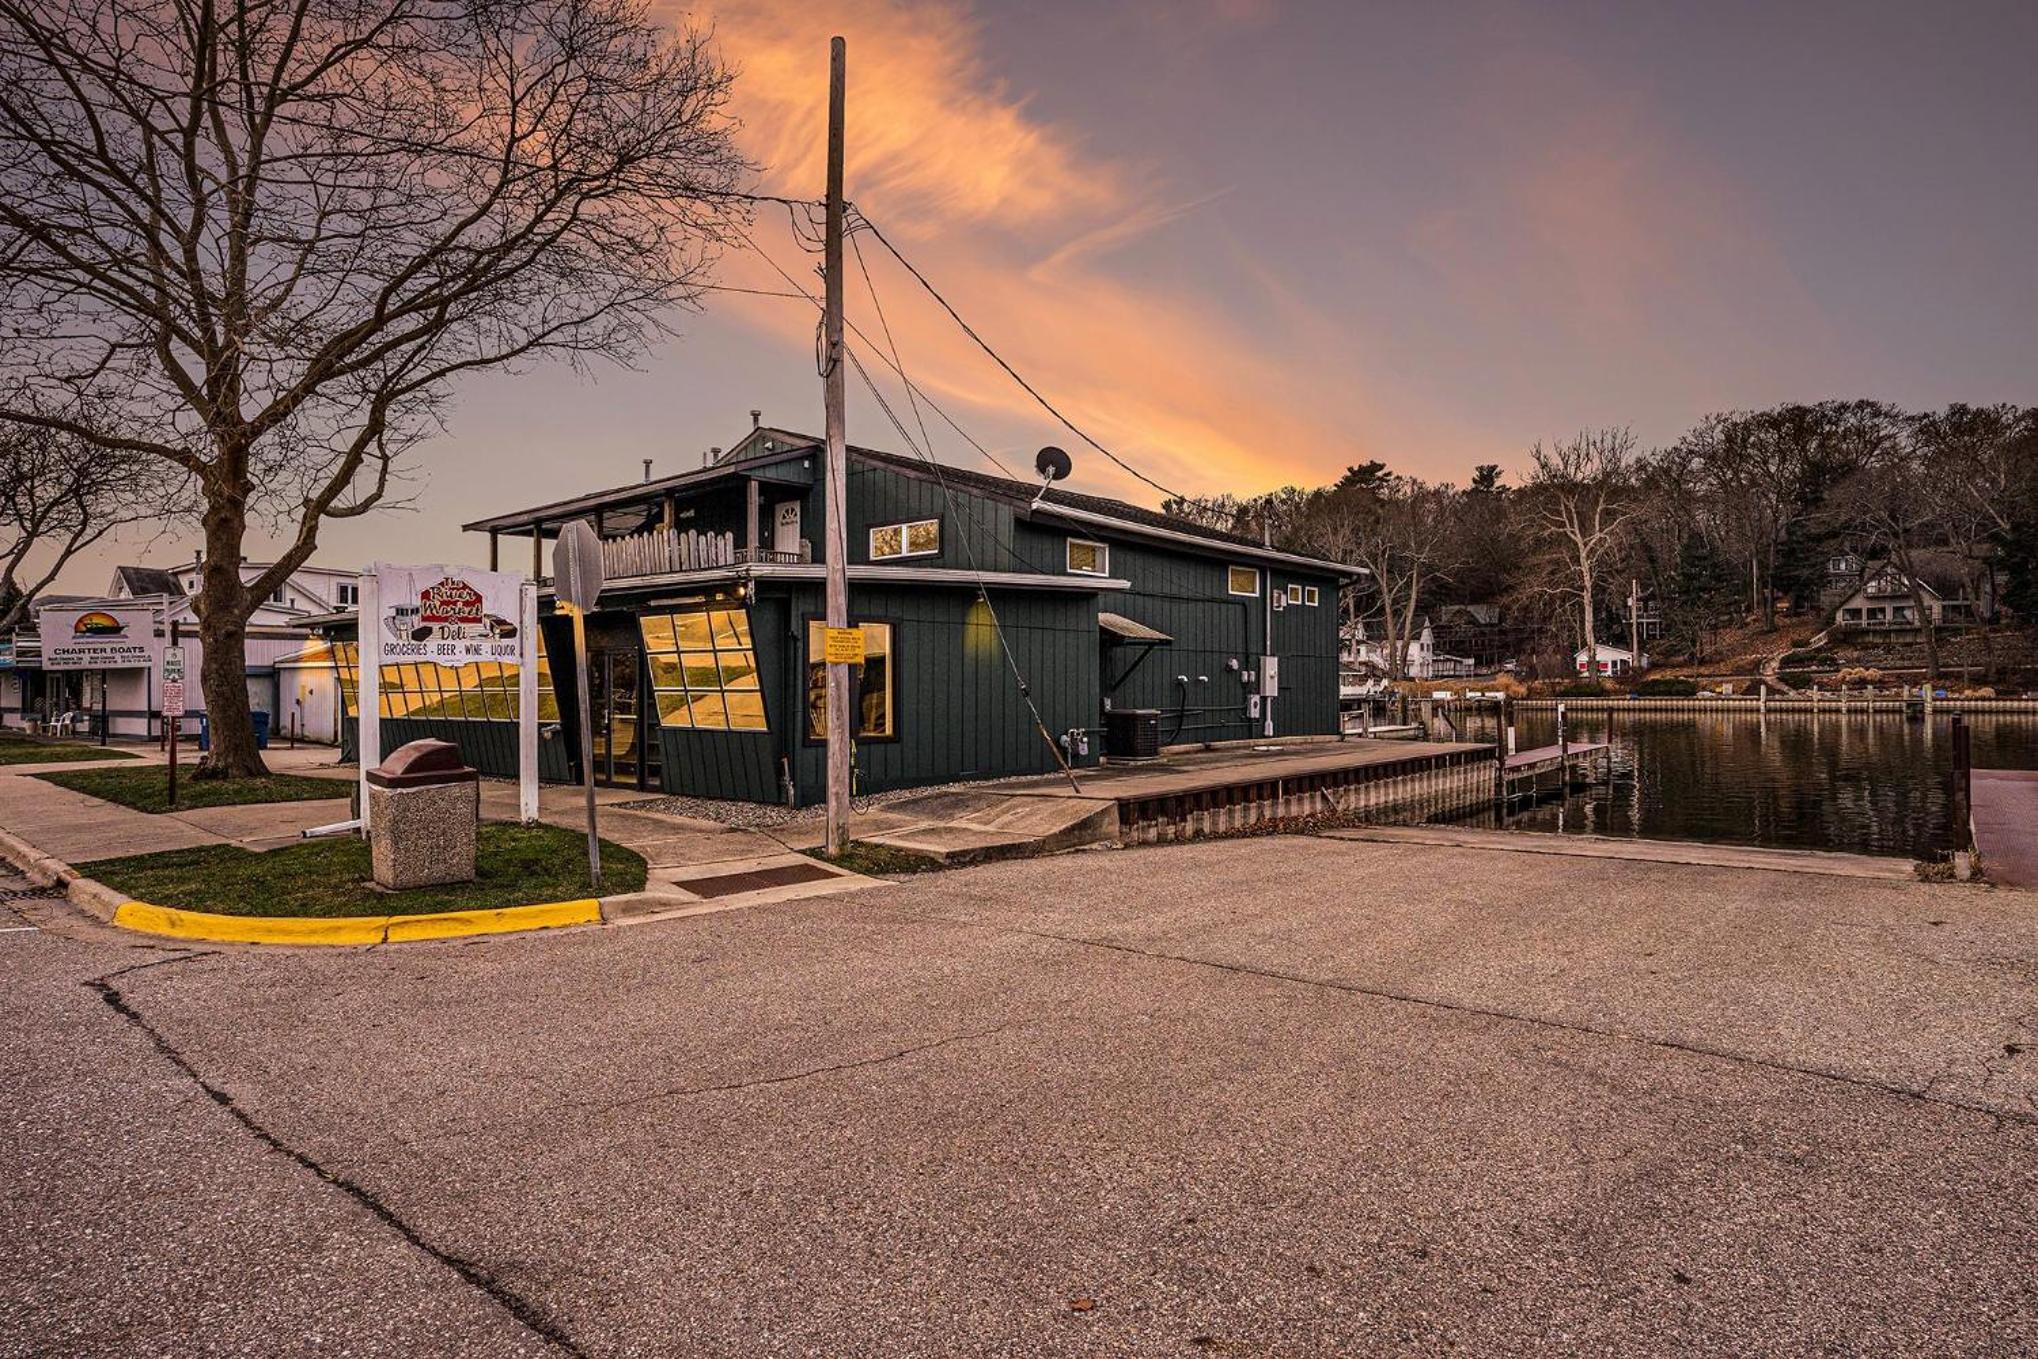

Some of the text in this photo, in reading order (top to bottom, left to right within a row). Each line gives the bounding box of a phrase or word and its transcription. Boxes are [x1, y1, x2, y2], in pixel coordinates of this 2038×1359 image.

[442, 576, 463, 587] The
[430, 586, 474, 600] River
[421, 599, 482, 617] Market
[438, 625, 467, 640] Deli
[54, 646, 145, 655] CHARTER BOATS
[383, 642, 516, 656] GROCERIES BEER WINE LIQUOR
